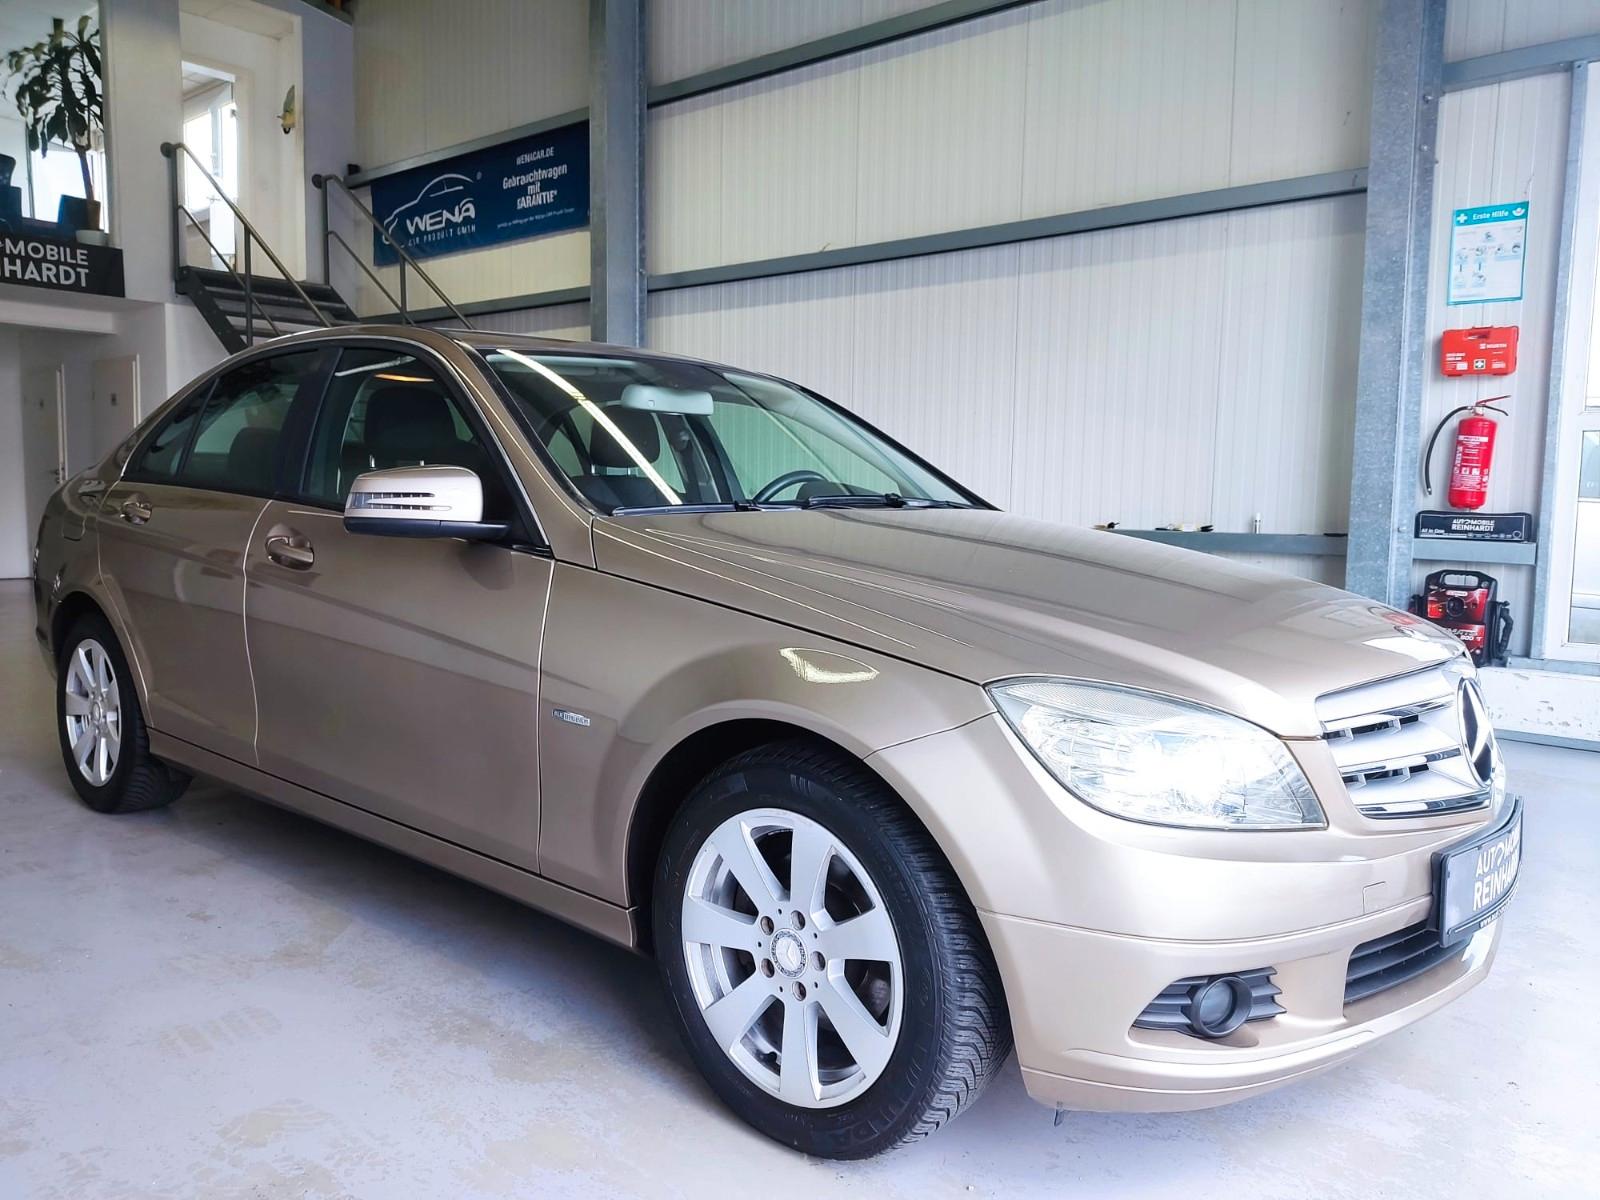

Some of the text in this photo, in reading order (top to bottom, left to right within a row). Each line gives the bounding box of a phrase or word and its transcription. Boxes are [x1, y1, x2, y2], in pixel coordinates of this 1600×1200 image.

[527, 181, 540, 195] mit
[0, 238, 89, 266] MOBILE
[0, 257, 89, 288] HARDT
[1451, 524, 1495, 532] REINHARDT
